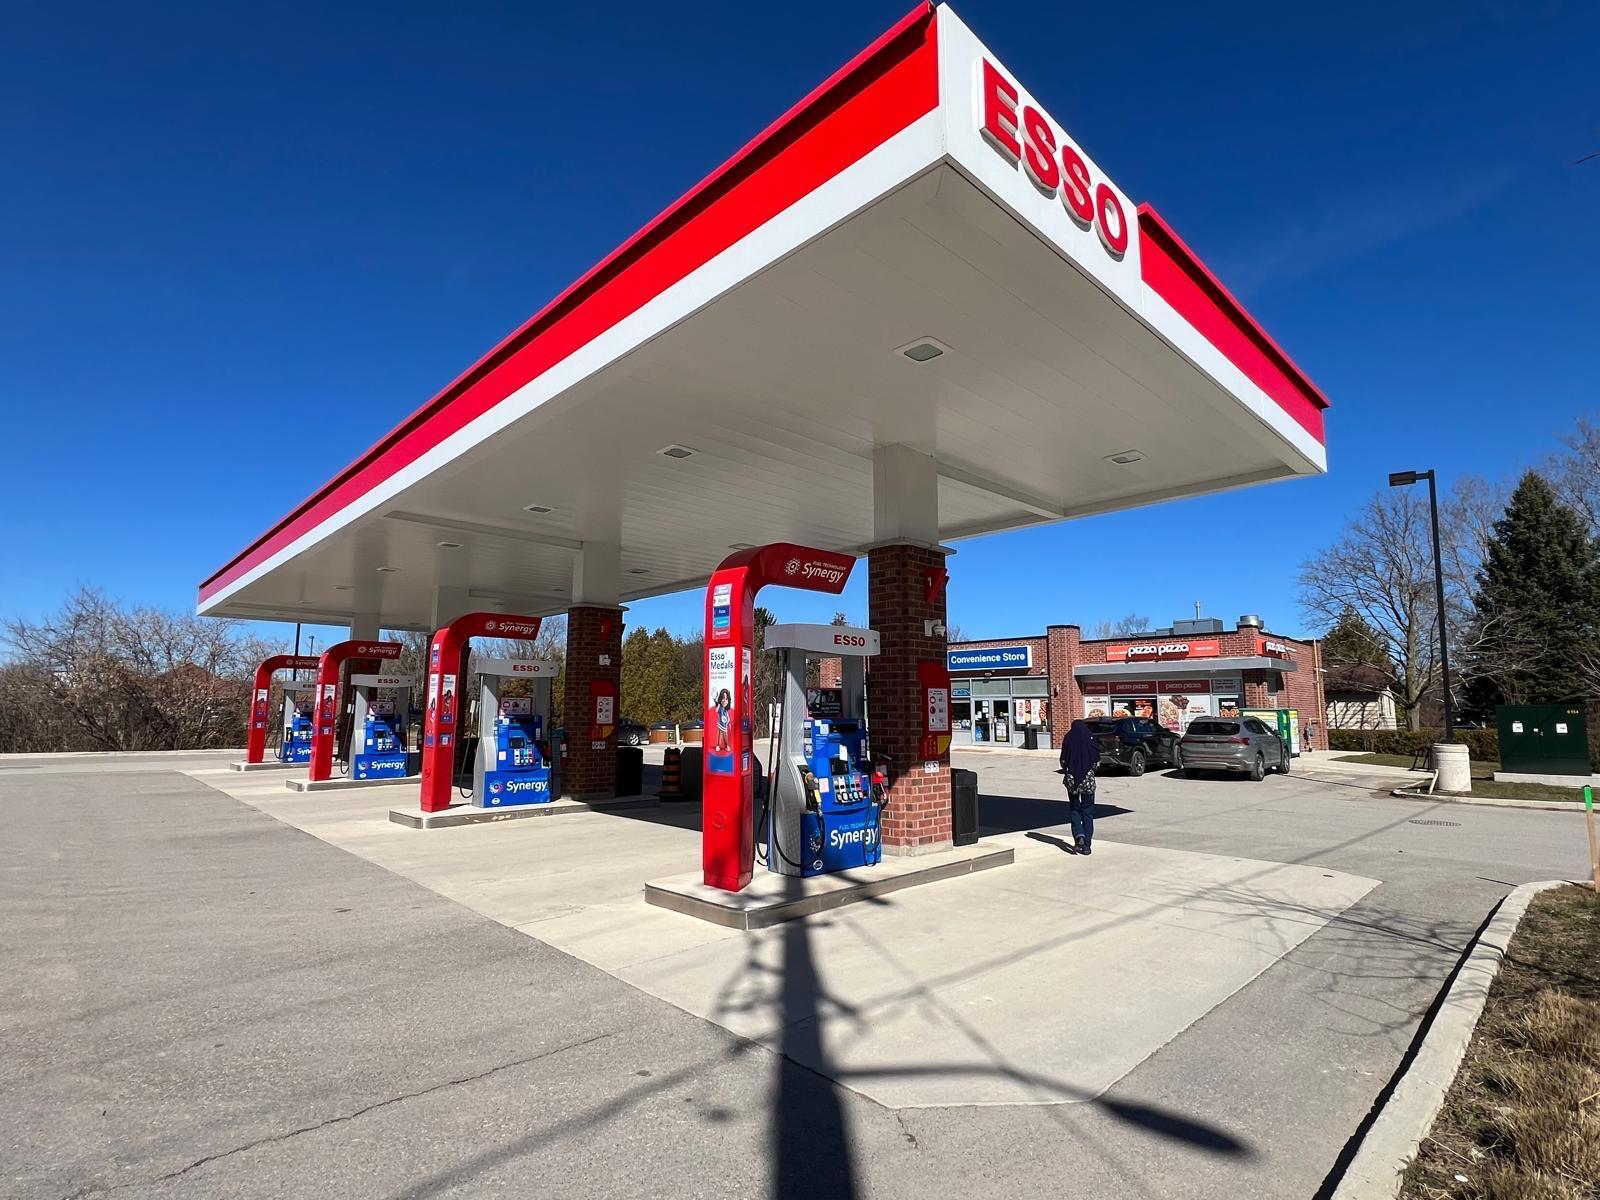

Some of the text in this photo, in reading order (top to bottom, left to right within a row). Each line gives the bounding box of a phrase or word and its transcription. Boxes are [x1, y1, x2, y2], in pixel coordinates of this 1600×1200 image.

[980, 56, 1128, 257] ESSO
[801, 562, 844, 584] Synergy
[498, 622, 535, 635] Synergy
[833, 634, 866, 647] ESSO
[368, 646, 397, 655] Synergy
[710, 652, 725, 661] Esso
[1128, 645, 1157, 658] pizza
[1158, 643, 1189, 656] pizza
[951, 652, 1026, 663] Convenience Store
[512, 664, 540, 673] ESSO
[710, 660, 734, 670] Medals
[371, 760, 405, 771] Synergy
[506, 781, 548, 794] Synergy
[830, 827, 878, 850] Synergy
